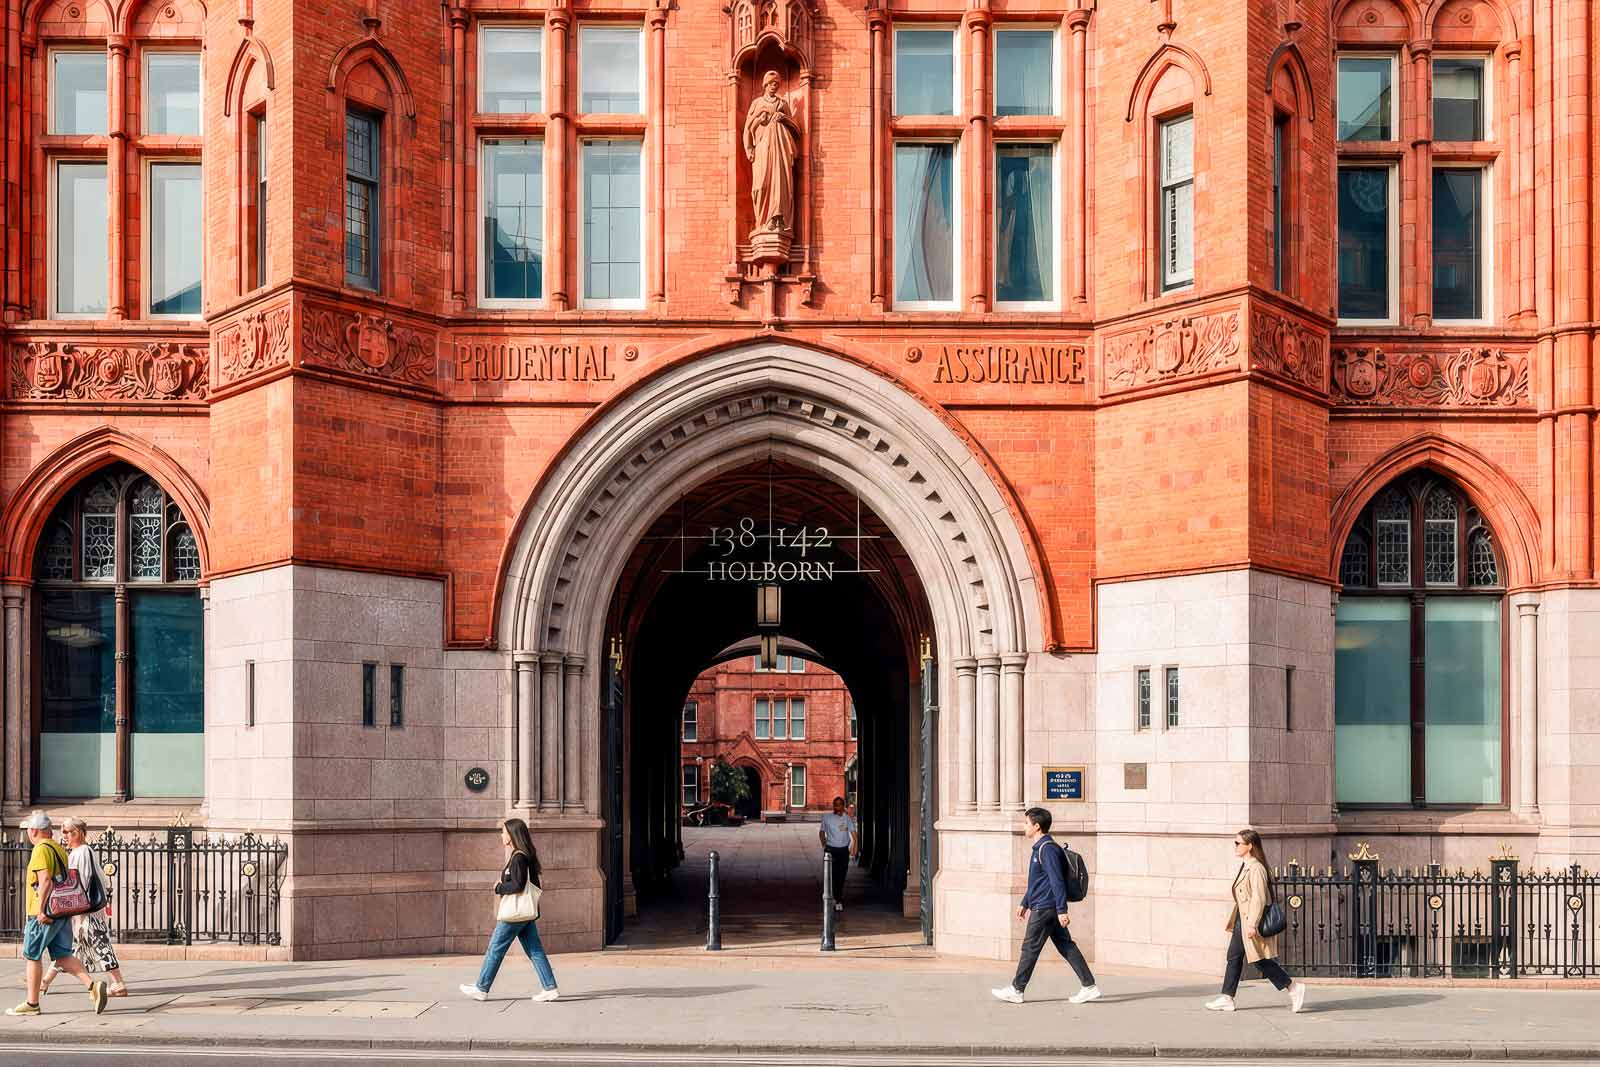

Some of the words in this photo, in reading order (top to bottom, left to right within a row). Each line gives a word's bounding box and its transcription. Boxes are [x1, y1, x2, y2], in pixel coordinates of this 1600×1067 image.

[455, 345, 615, 381] PRUDENTIAL
[933, 346, 1085, 384] ASSURANCE
[709, 517, 756, 556] 138
[776, 526, 832, 557] 142
[707, 561, 834, 581] HOLBORN
